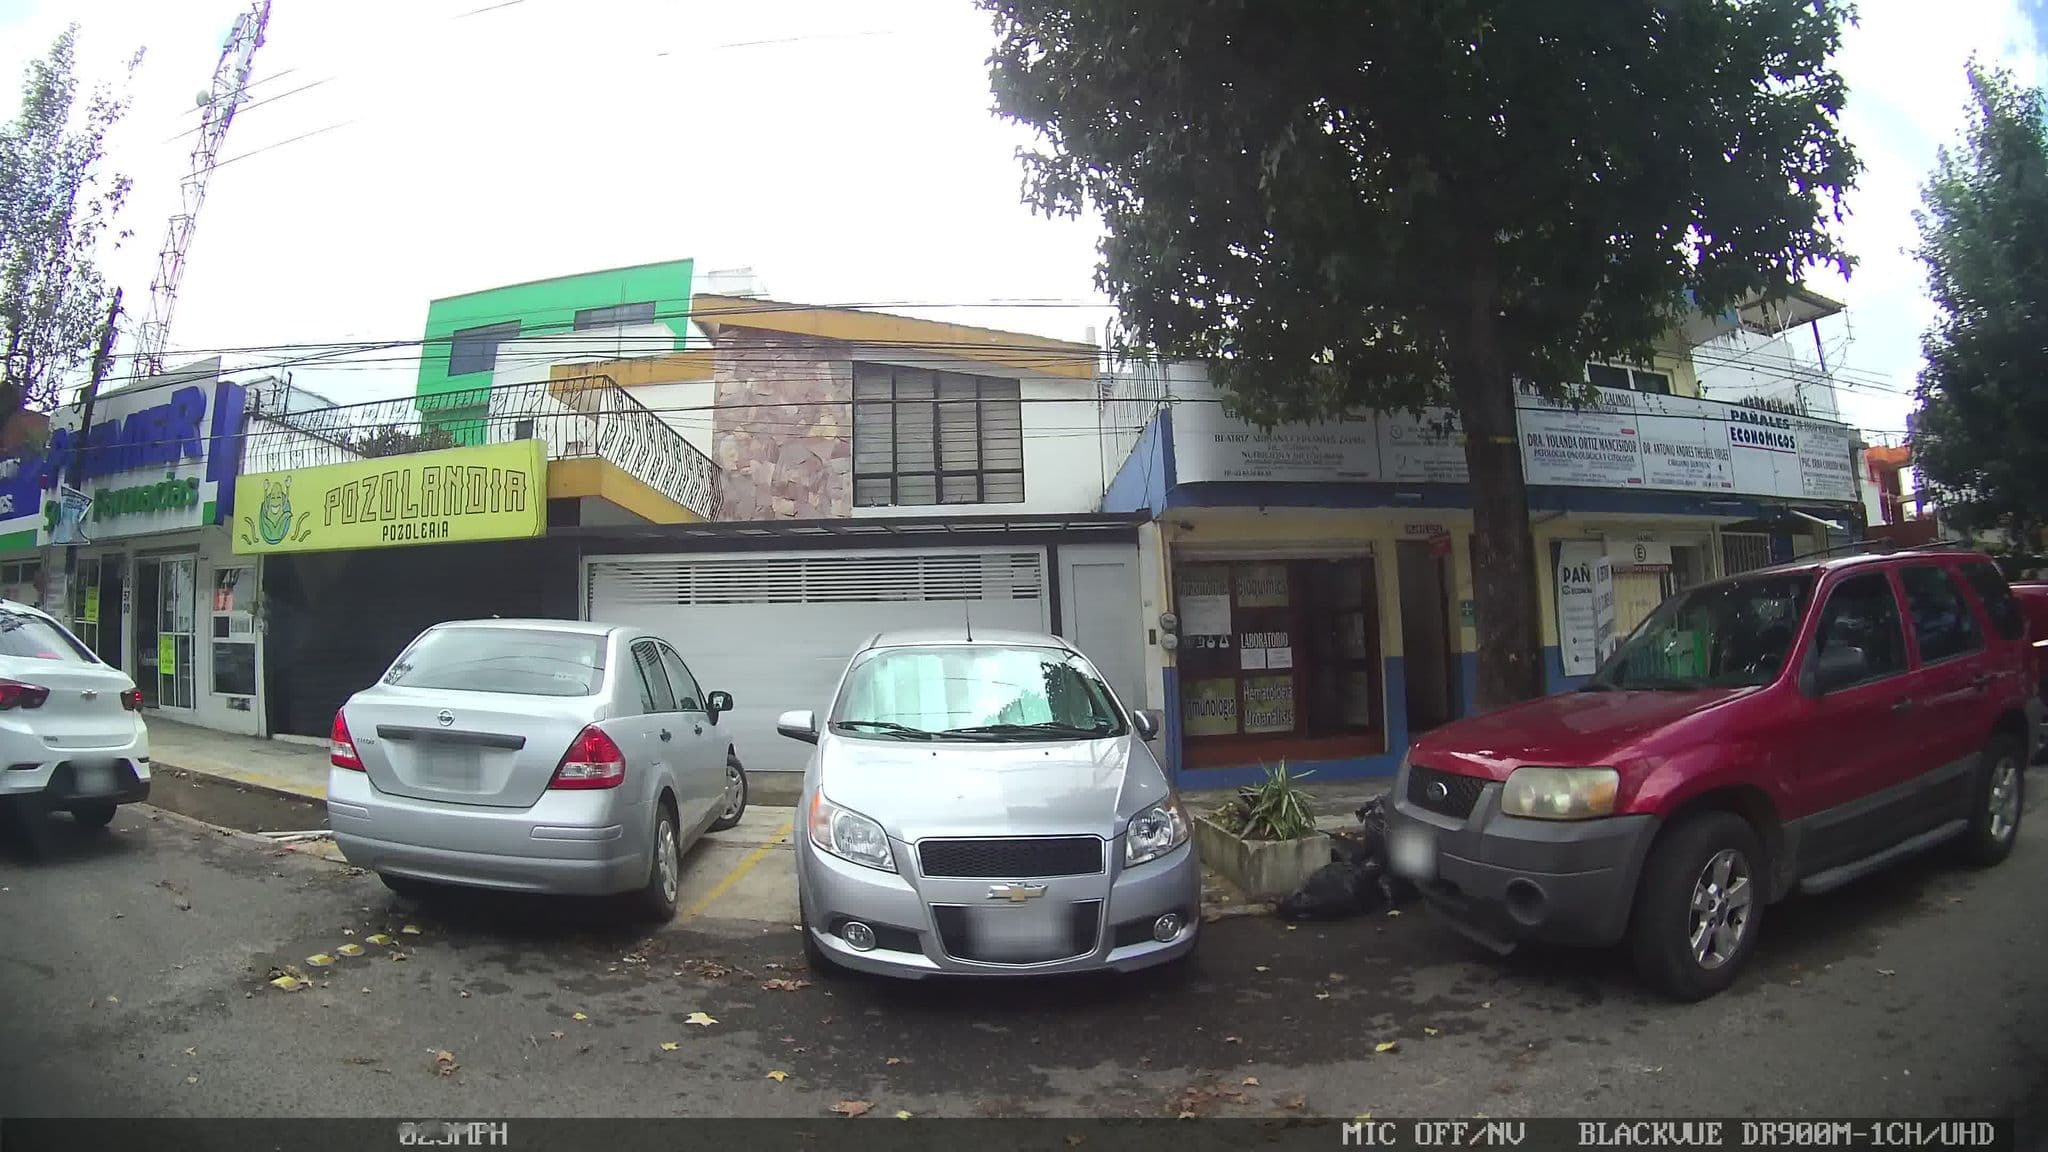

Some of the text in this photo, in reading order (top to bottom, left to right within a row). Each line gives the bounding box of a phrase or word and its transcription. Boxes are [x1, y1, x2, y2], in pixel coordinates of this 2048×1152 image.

[1731, 409, 1791, 430] PAÑALES
[1546, 434, 1577, 449] YOLANDA
[1579, 437, 1598, 450] ORTIZ
[324, 465, 527, 526] POZOLANDIA
[1240, 632, 1288, 649] LABORATORIO
